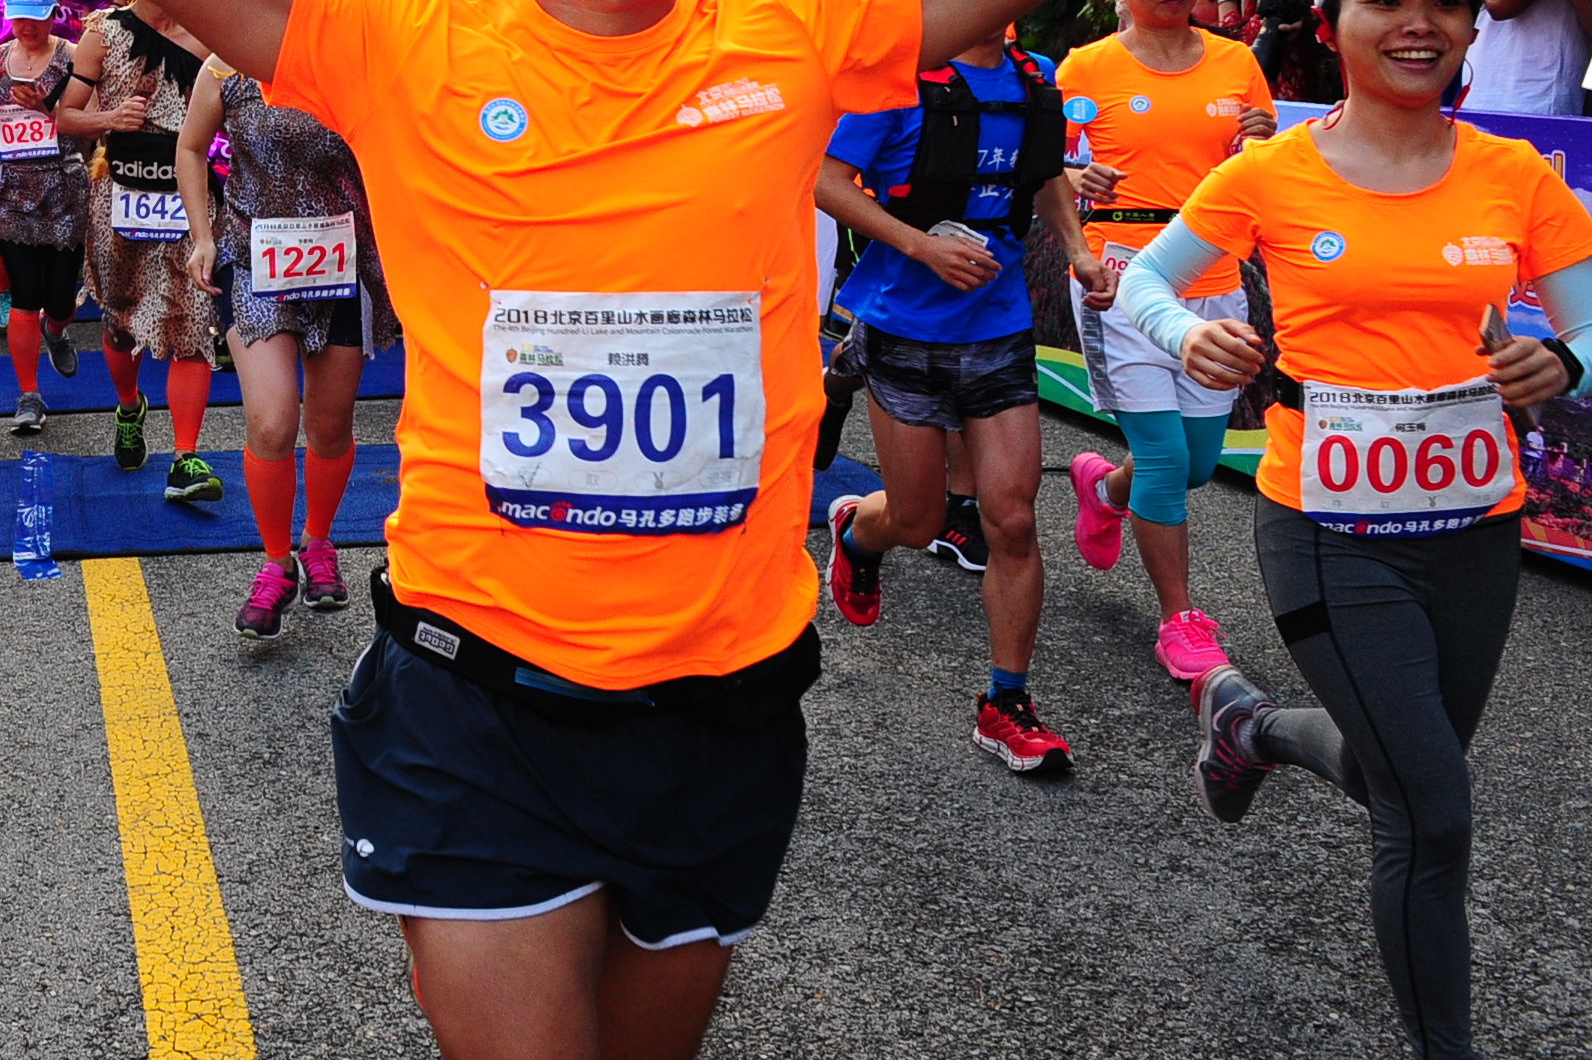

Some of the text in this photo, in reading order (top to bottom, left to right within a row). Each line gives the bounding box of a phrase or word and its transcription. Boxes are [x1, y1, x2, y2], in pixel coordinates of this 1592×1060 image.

[1, 120, 56, 145] 0287
[119, 193, 187, 221] 1642
[261, 242, 346, 280] 1221
[502, 372, 735, 462] 3901
[1317, 429, 1500, 493] 0060
[501, 500, 744, 528] macondo 马孔多跑步装备
